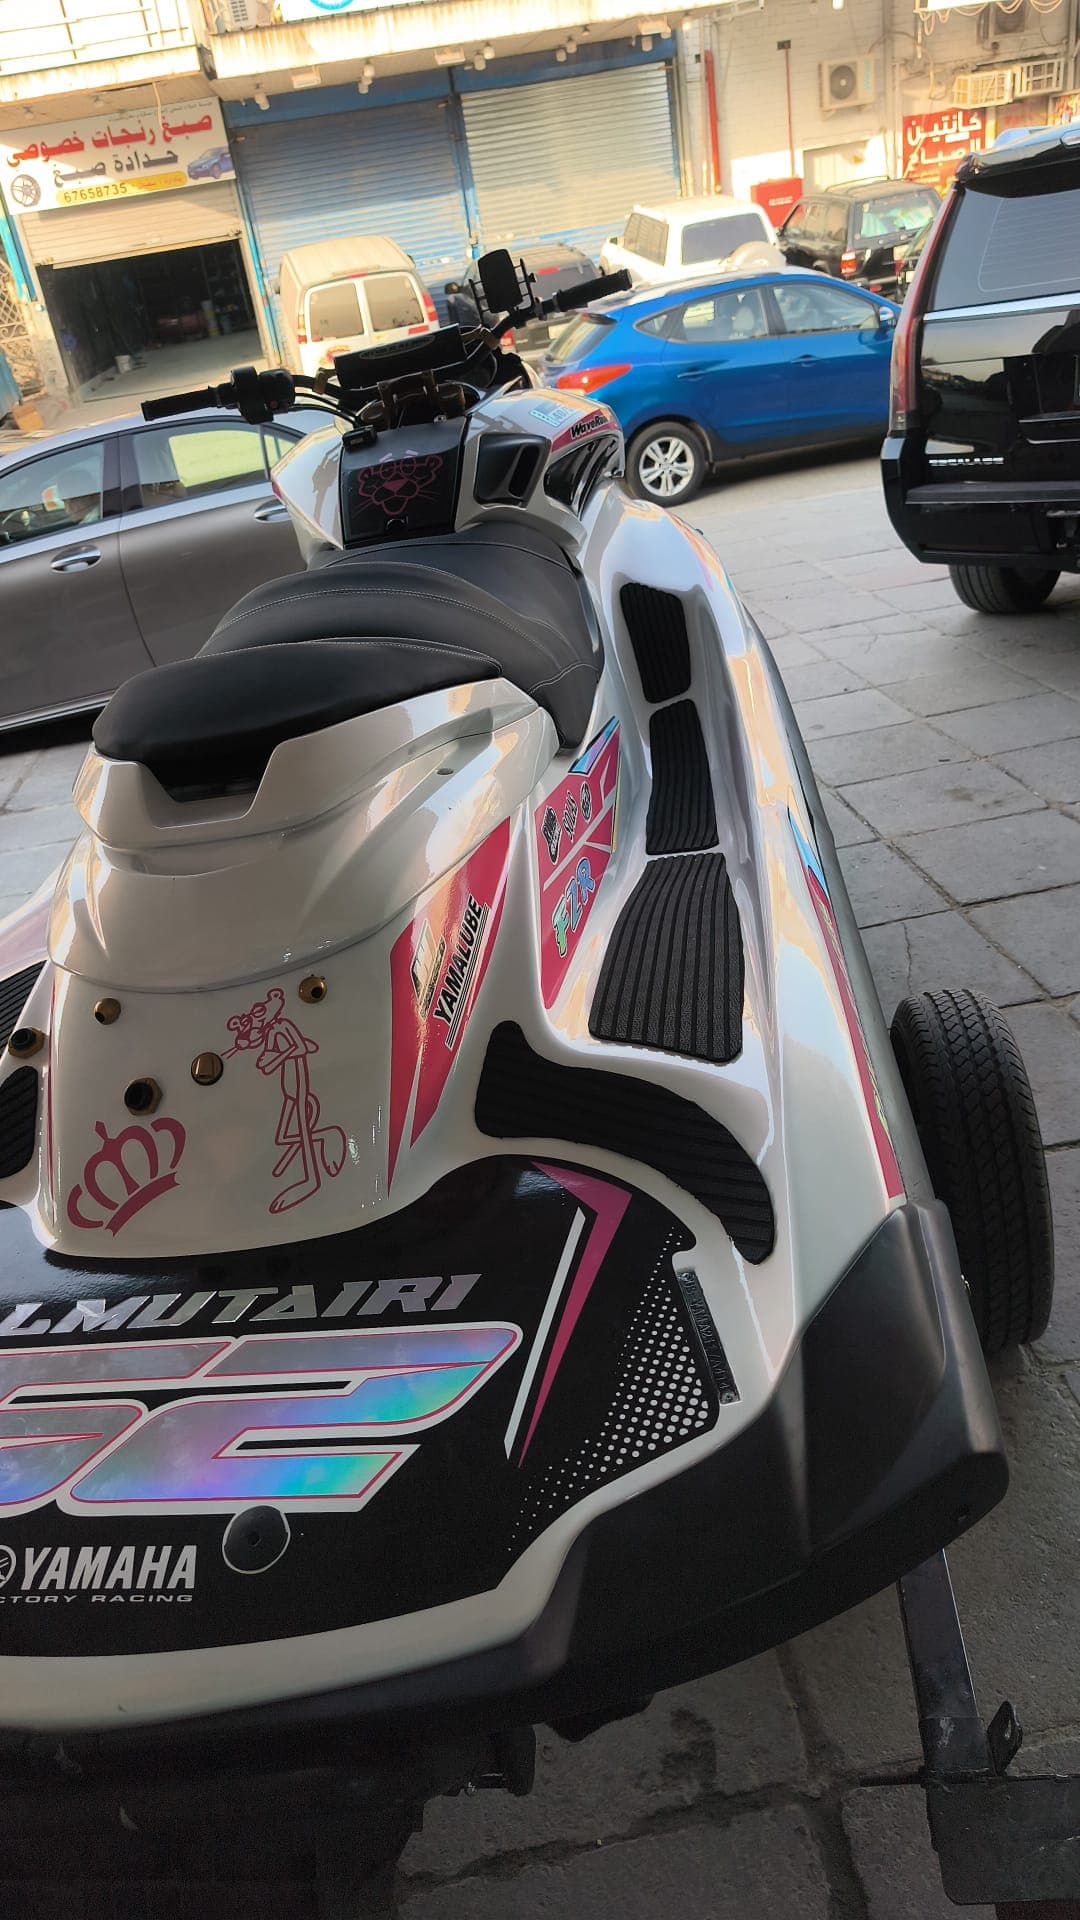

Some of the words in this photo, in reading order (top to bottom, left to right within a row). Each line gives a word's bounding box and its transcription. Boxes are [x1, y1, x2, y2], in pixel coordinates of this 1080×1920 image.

[161, 115, 213, 143] صبغ
[906, 111, 982, 146] كانتين
[53, 161, 107, 188] صبغ
[113, 149, 179, 173] حدادة
[63, 182, 128, 204] 67658735
[552, 857, 596, 957] FZR
[433, 894, 483, 1026] YAMALUBE
[20, 1545, 197, 1590] YAMAHA
[0, 1595, 77, 1604] TORY
[91, 1594, 193, 1603] RACING
